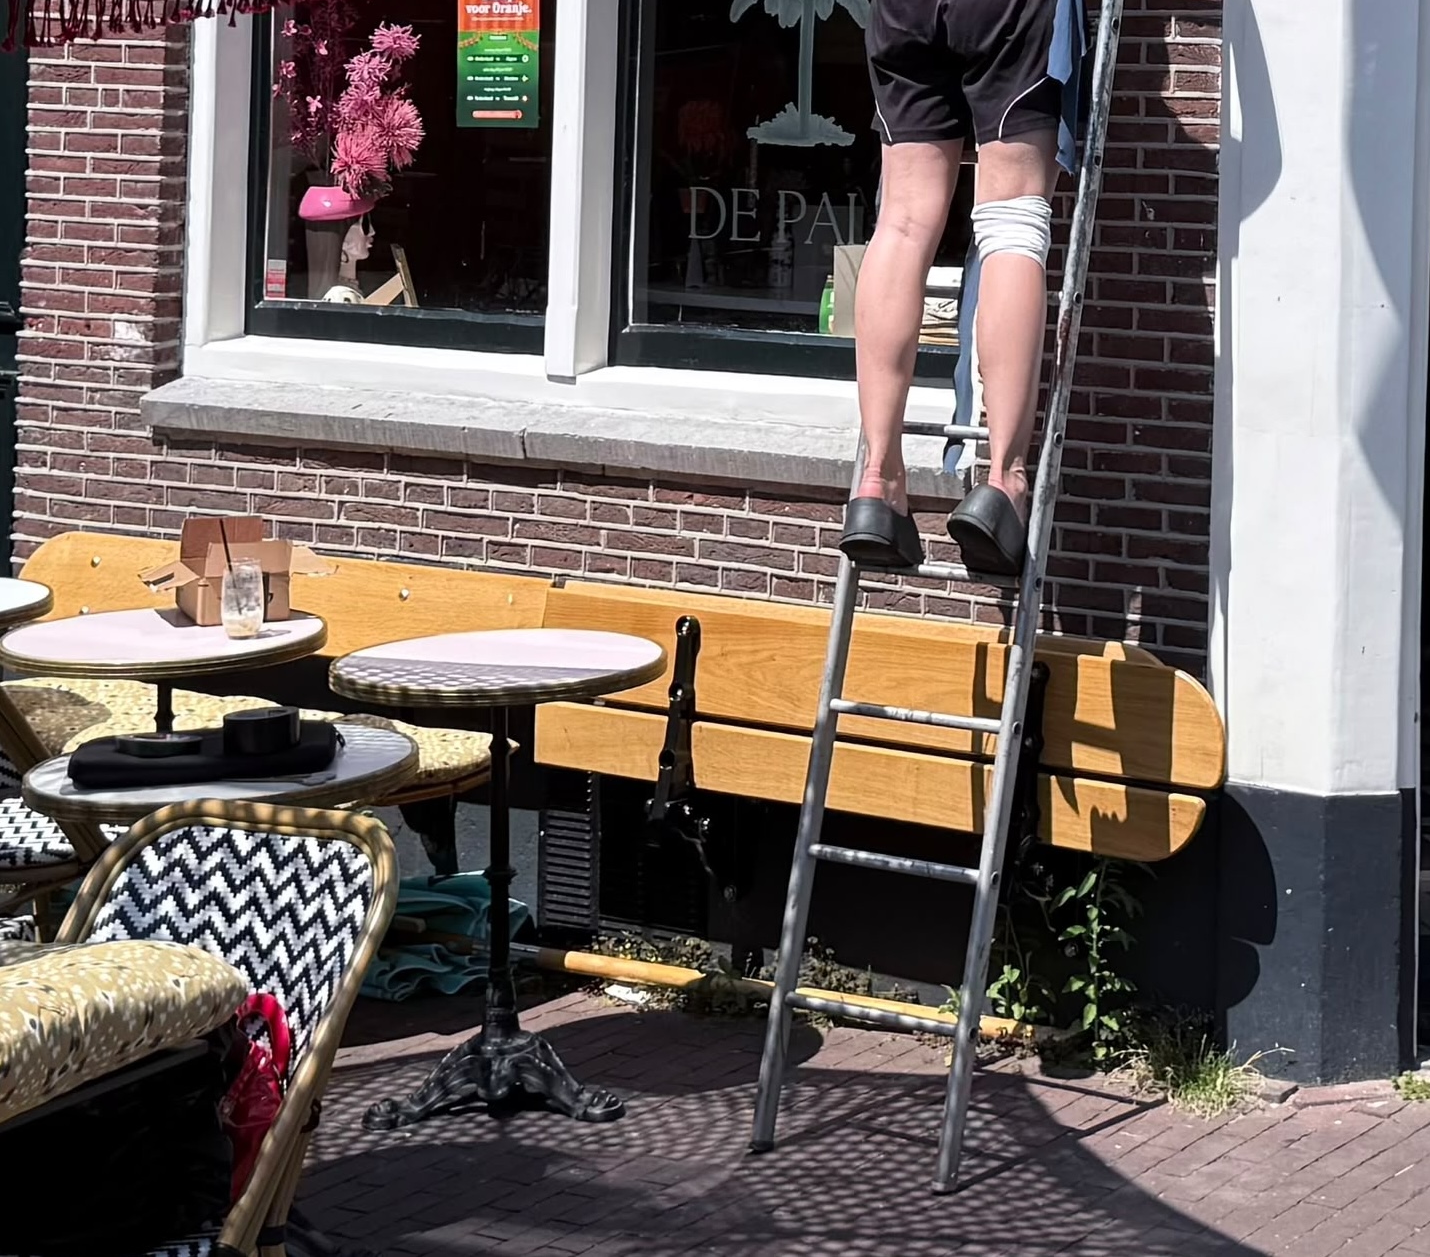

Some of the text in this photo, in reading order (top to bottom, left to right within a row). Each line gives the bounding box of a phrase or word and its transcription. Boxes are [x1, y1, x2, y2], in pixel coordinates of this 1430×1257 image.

[465, 1, 533, 16] voor Oranje.
[688, 186, 761, 242] DE
